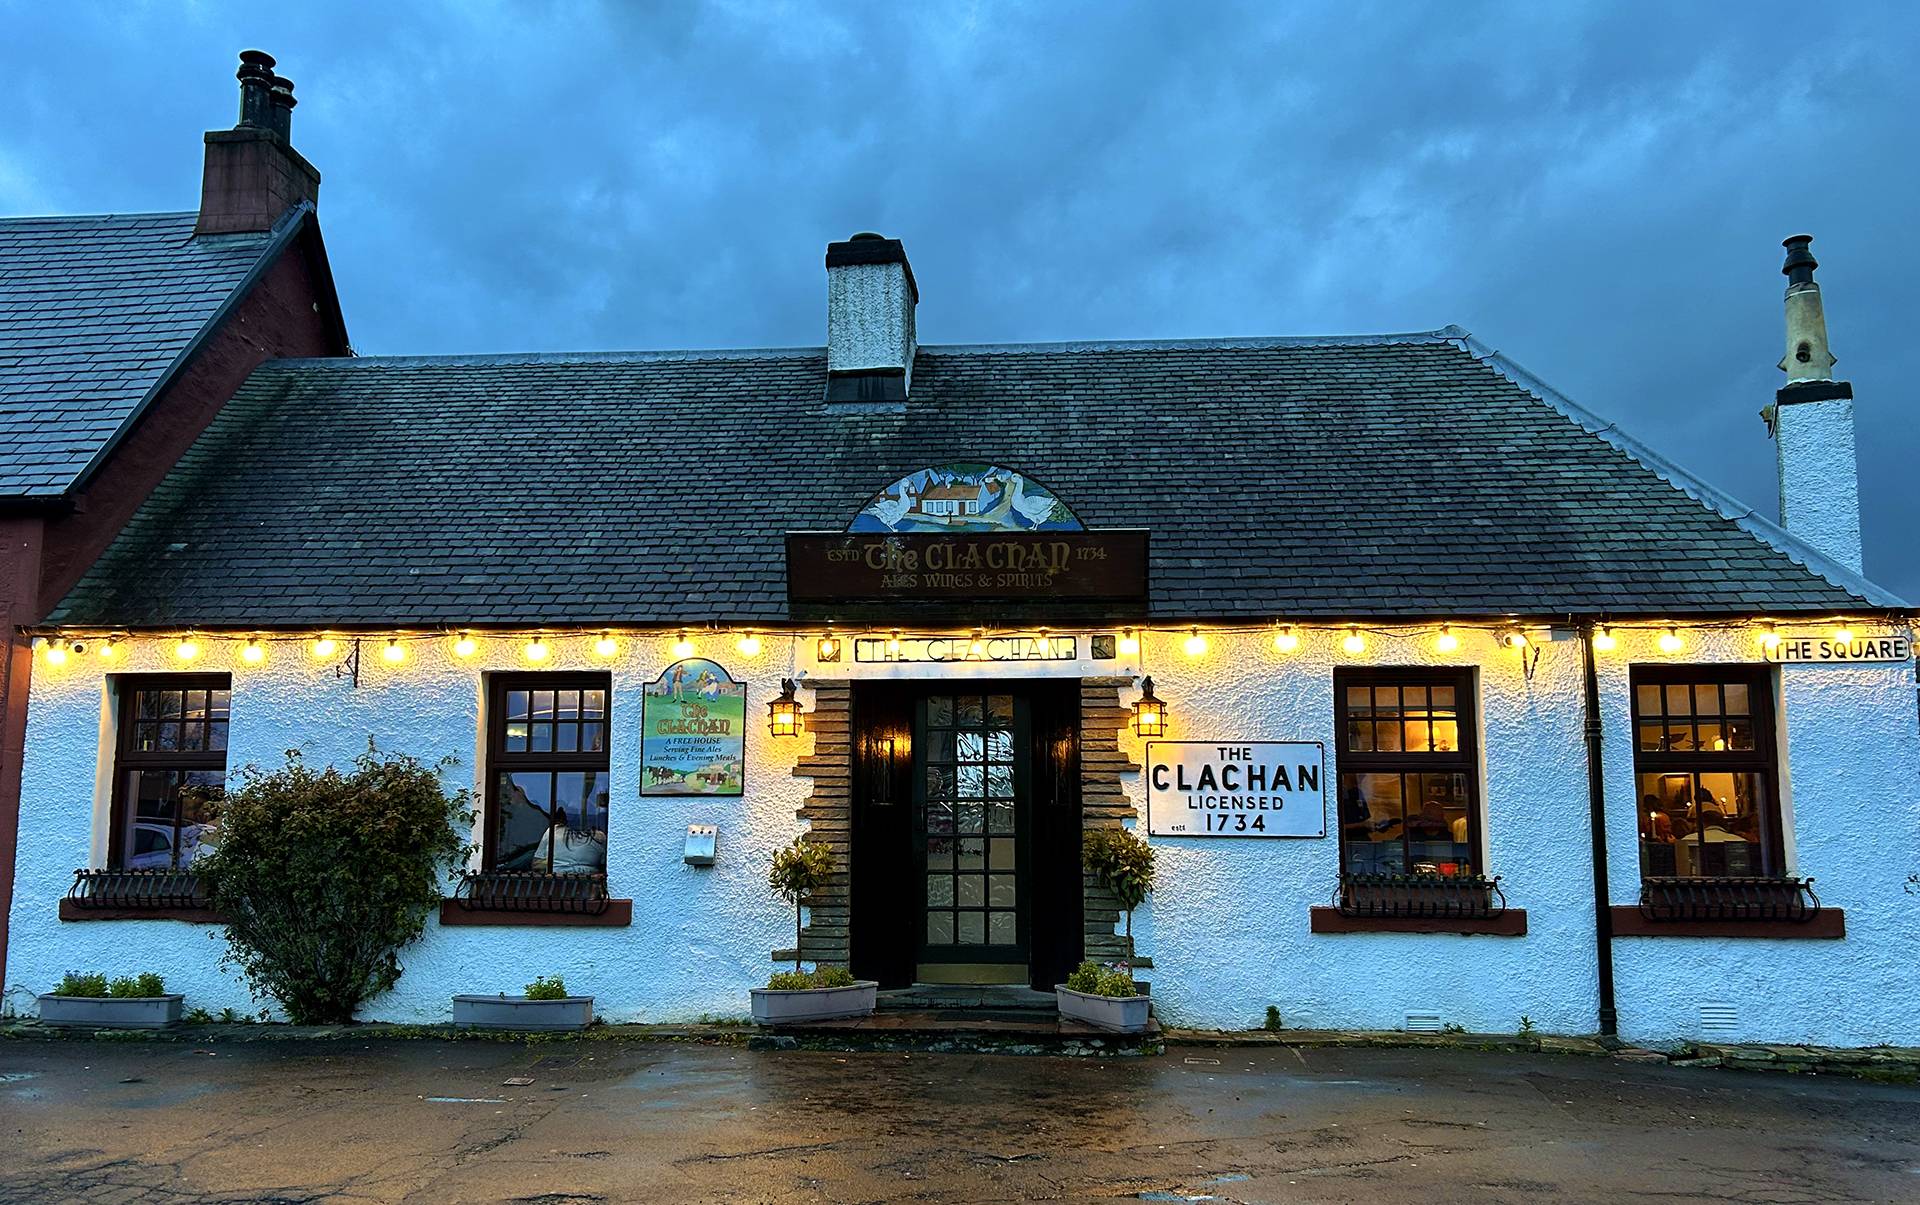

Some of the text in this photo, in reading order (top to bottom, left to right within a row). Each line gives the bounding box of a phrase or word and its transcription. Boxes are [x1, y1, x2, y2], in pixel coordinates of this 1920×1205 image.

[827, 549, 860, 561] ESTD
[864, 543, 918, 572] The
[1075, 547, 1107, 560] 1734
[923, 573, 973, 588] WINES
[978, 573, 992, 588] &
[997, 573, 1053, 589] SPIRITS
[1775, 640, 1906, 660] THE SQUARE
[673, 737, 692, 745] FREE
[693, 737, 721, 745] HOUSE
[690, 745, 705, 753] Fine
[706, 745, 722, 753] Ales
[715, 752, 736, 761] Meals
[1217, 747, 1252, 761] THE
[1152, 764, 1318, 792] CLACHAN
[1188, 796, 1283, 810] LICENSED
[1206, 813, 1266, 832] 1734
